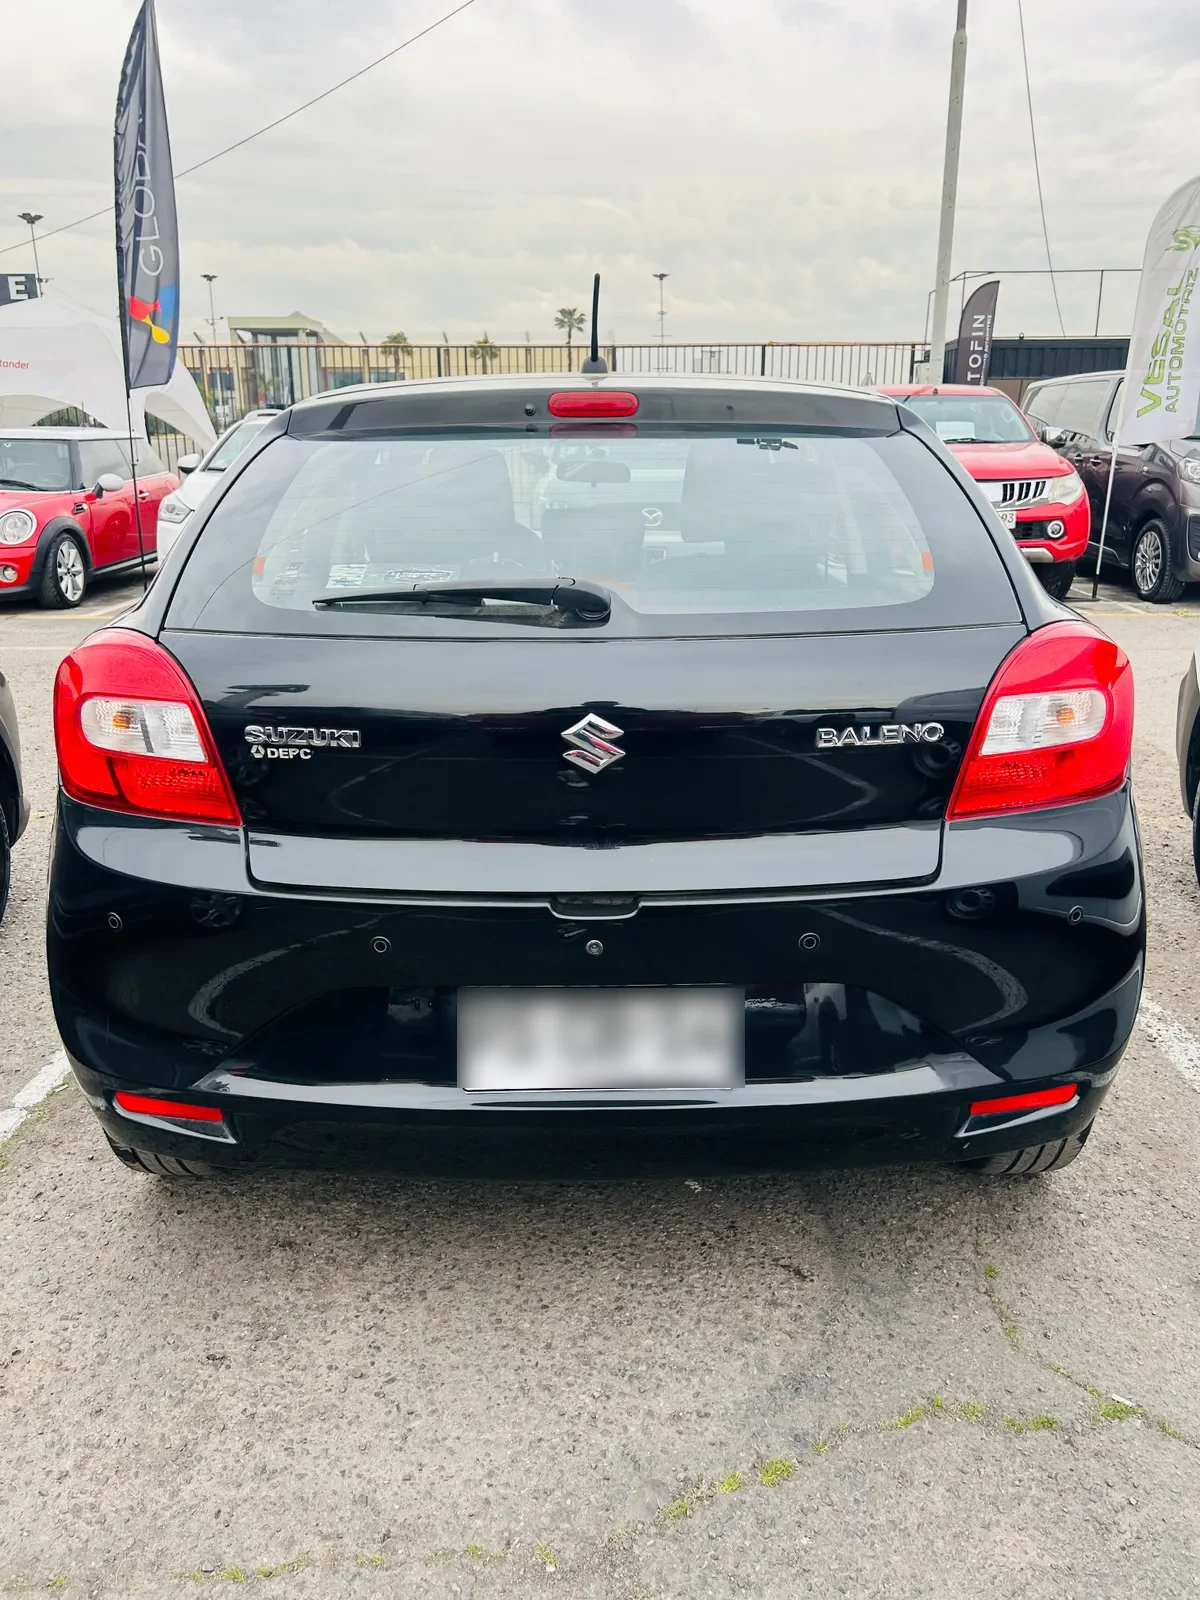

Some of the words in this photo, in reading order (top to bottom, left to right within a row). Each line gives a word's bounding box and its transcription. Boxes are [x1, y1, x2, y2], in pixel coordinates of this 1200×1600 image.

[8, 276, 29, 300] E
[1137, 269, 1187, 418] VESAL
[1165, 267, 1199, 413] AUTOMOTRIZ
[244, 725, 361, 748] SUZUKI
[816, 722, 945, 748] BALENO
[267, 747, 312, 759] DEPC
